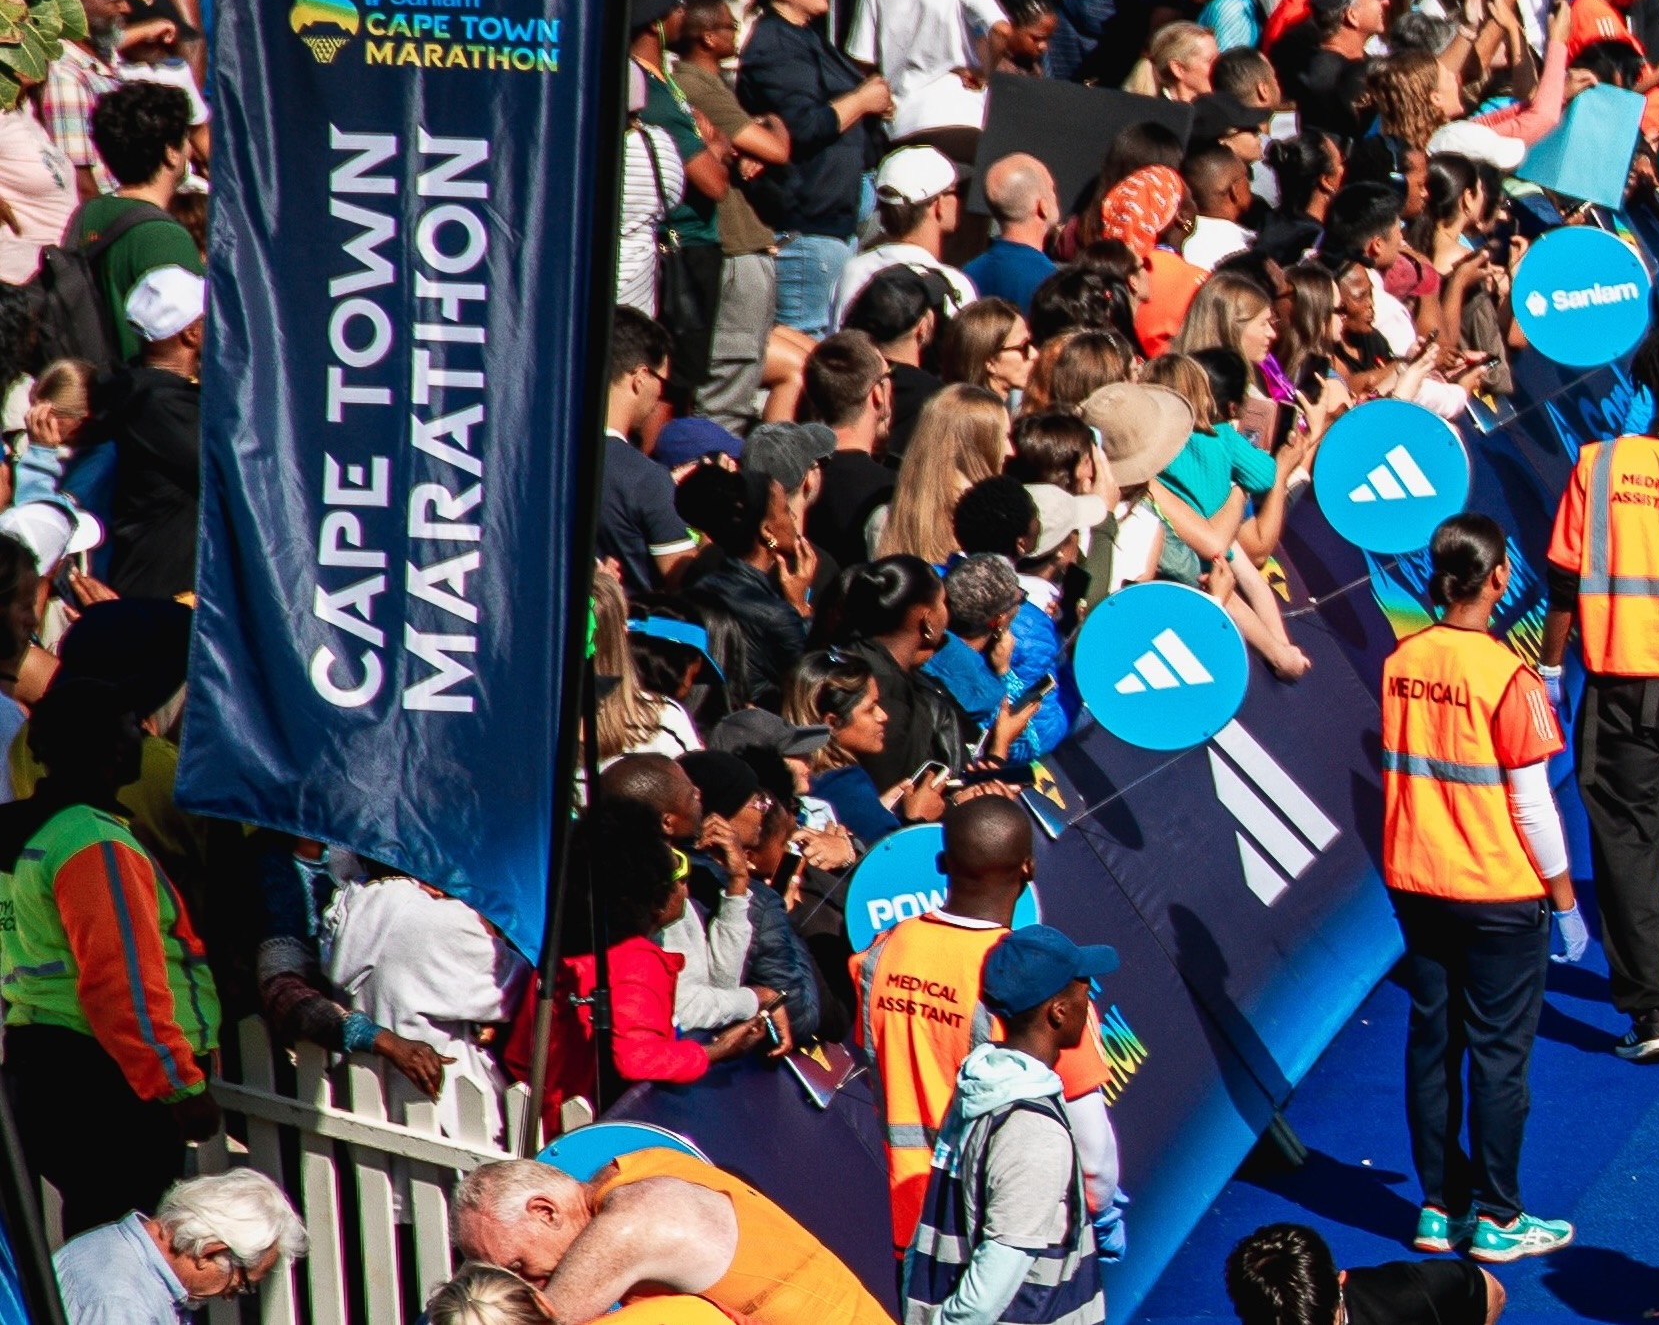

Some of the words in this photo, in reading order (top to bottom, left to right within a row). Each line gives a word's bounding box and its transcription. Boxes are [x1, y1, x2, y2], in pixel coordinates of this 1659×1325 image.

[366, 13, 451, 39] CAPE
[462, 16, 559, 42] TOWN
[365, 41, 559, 72] MARATHON
[327, 122, 399, 424] TOWN
[1552, 282, 1638, 311] Sanlam
[403, 124, 491, 713] MARATHON
[309, 454, 390, 710] CAPE
[1388, 676, 1468, 708] MEDICAL
[867, 886, 947, 930] POW
[886, 973, 958, 1004] MEDICAL
[876, 995, 965, 1030] ASSISTANT
